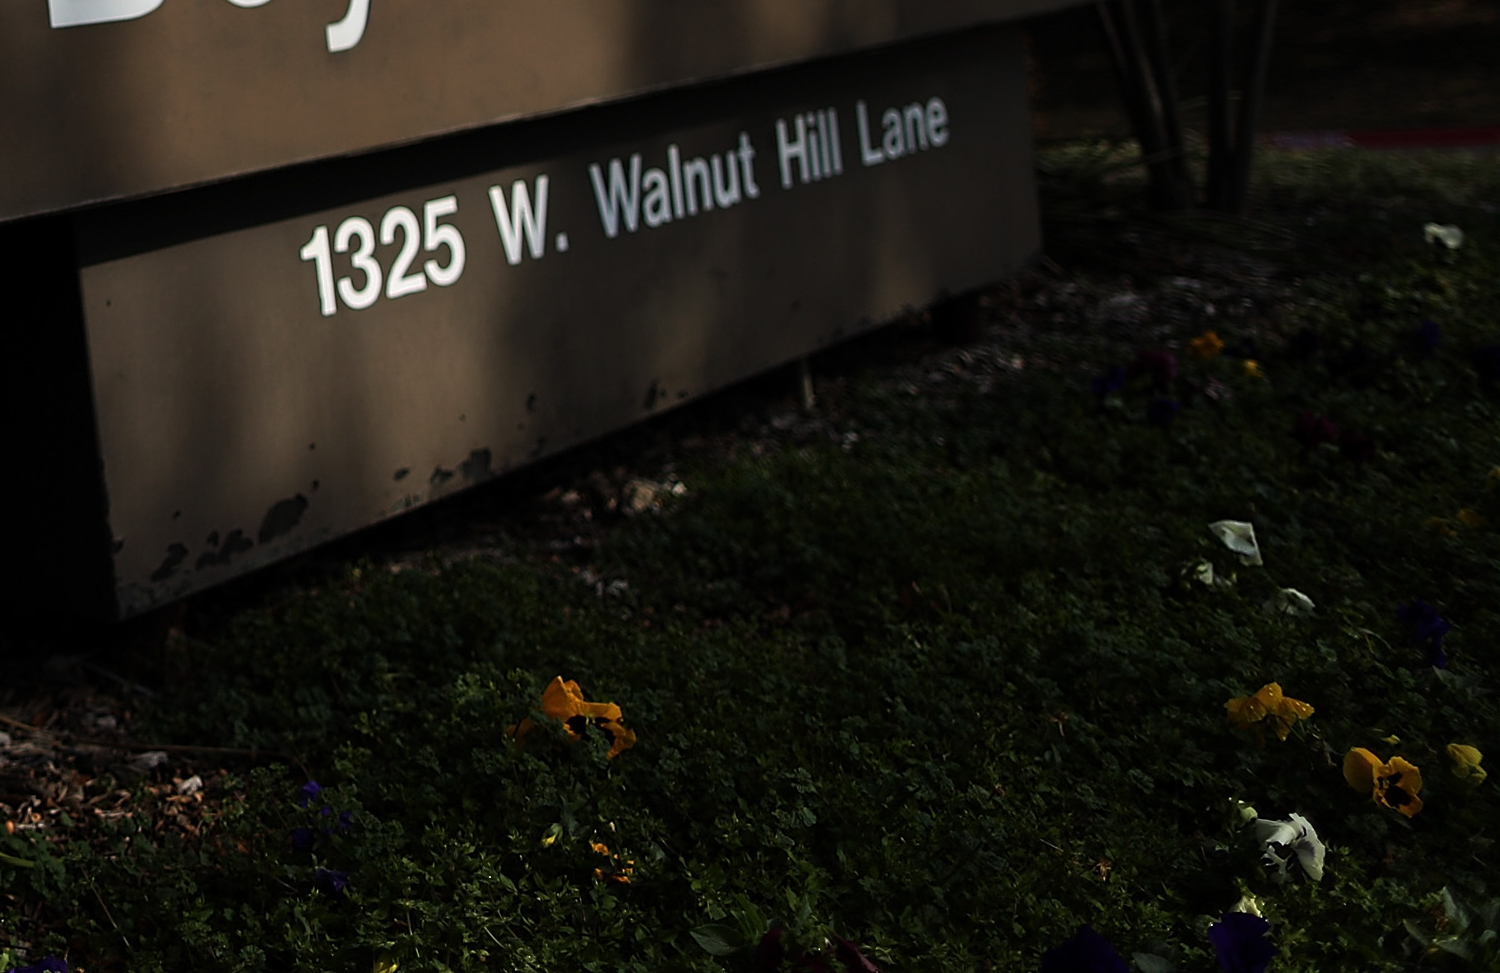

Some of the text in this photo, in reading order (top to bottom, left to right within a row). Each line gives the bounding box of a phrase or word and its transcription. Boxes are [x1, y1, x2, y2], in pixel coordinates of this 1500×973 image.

[299, 94, 948, 318] 1325 W. Walnut Hill Lane
